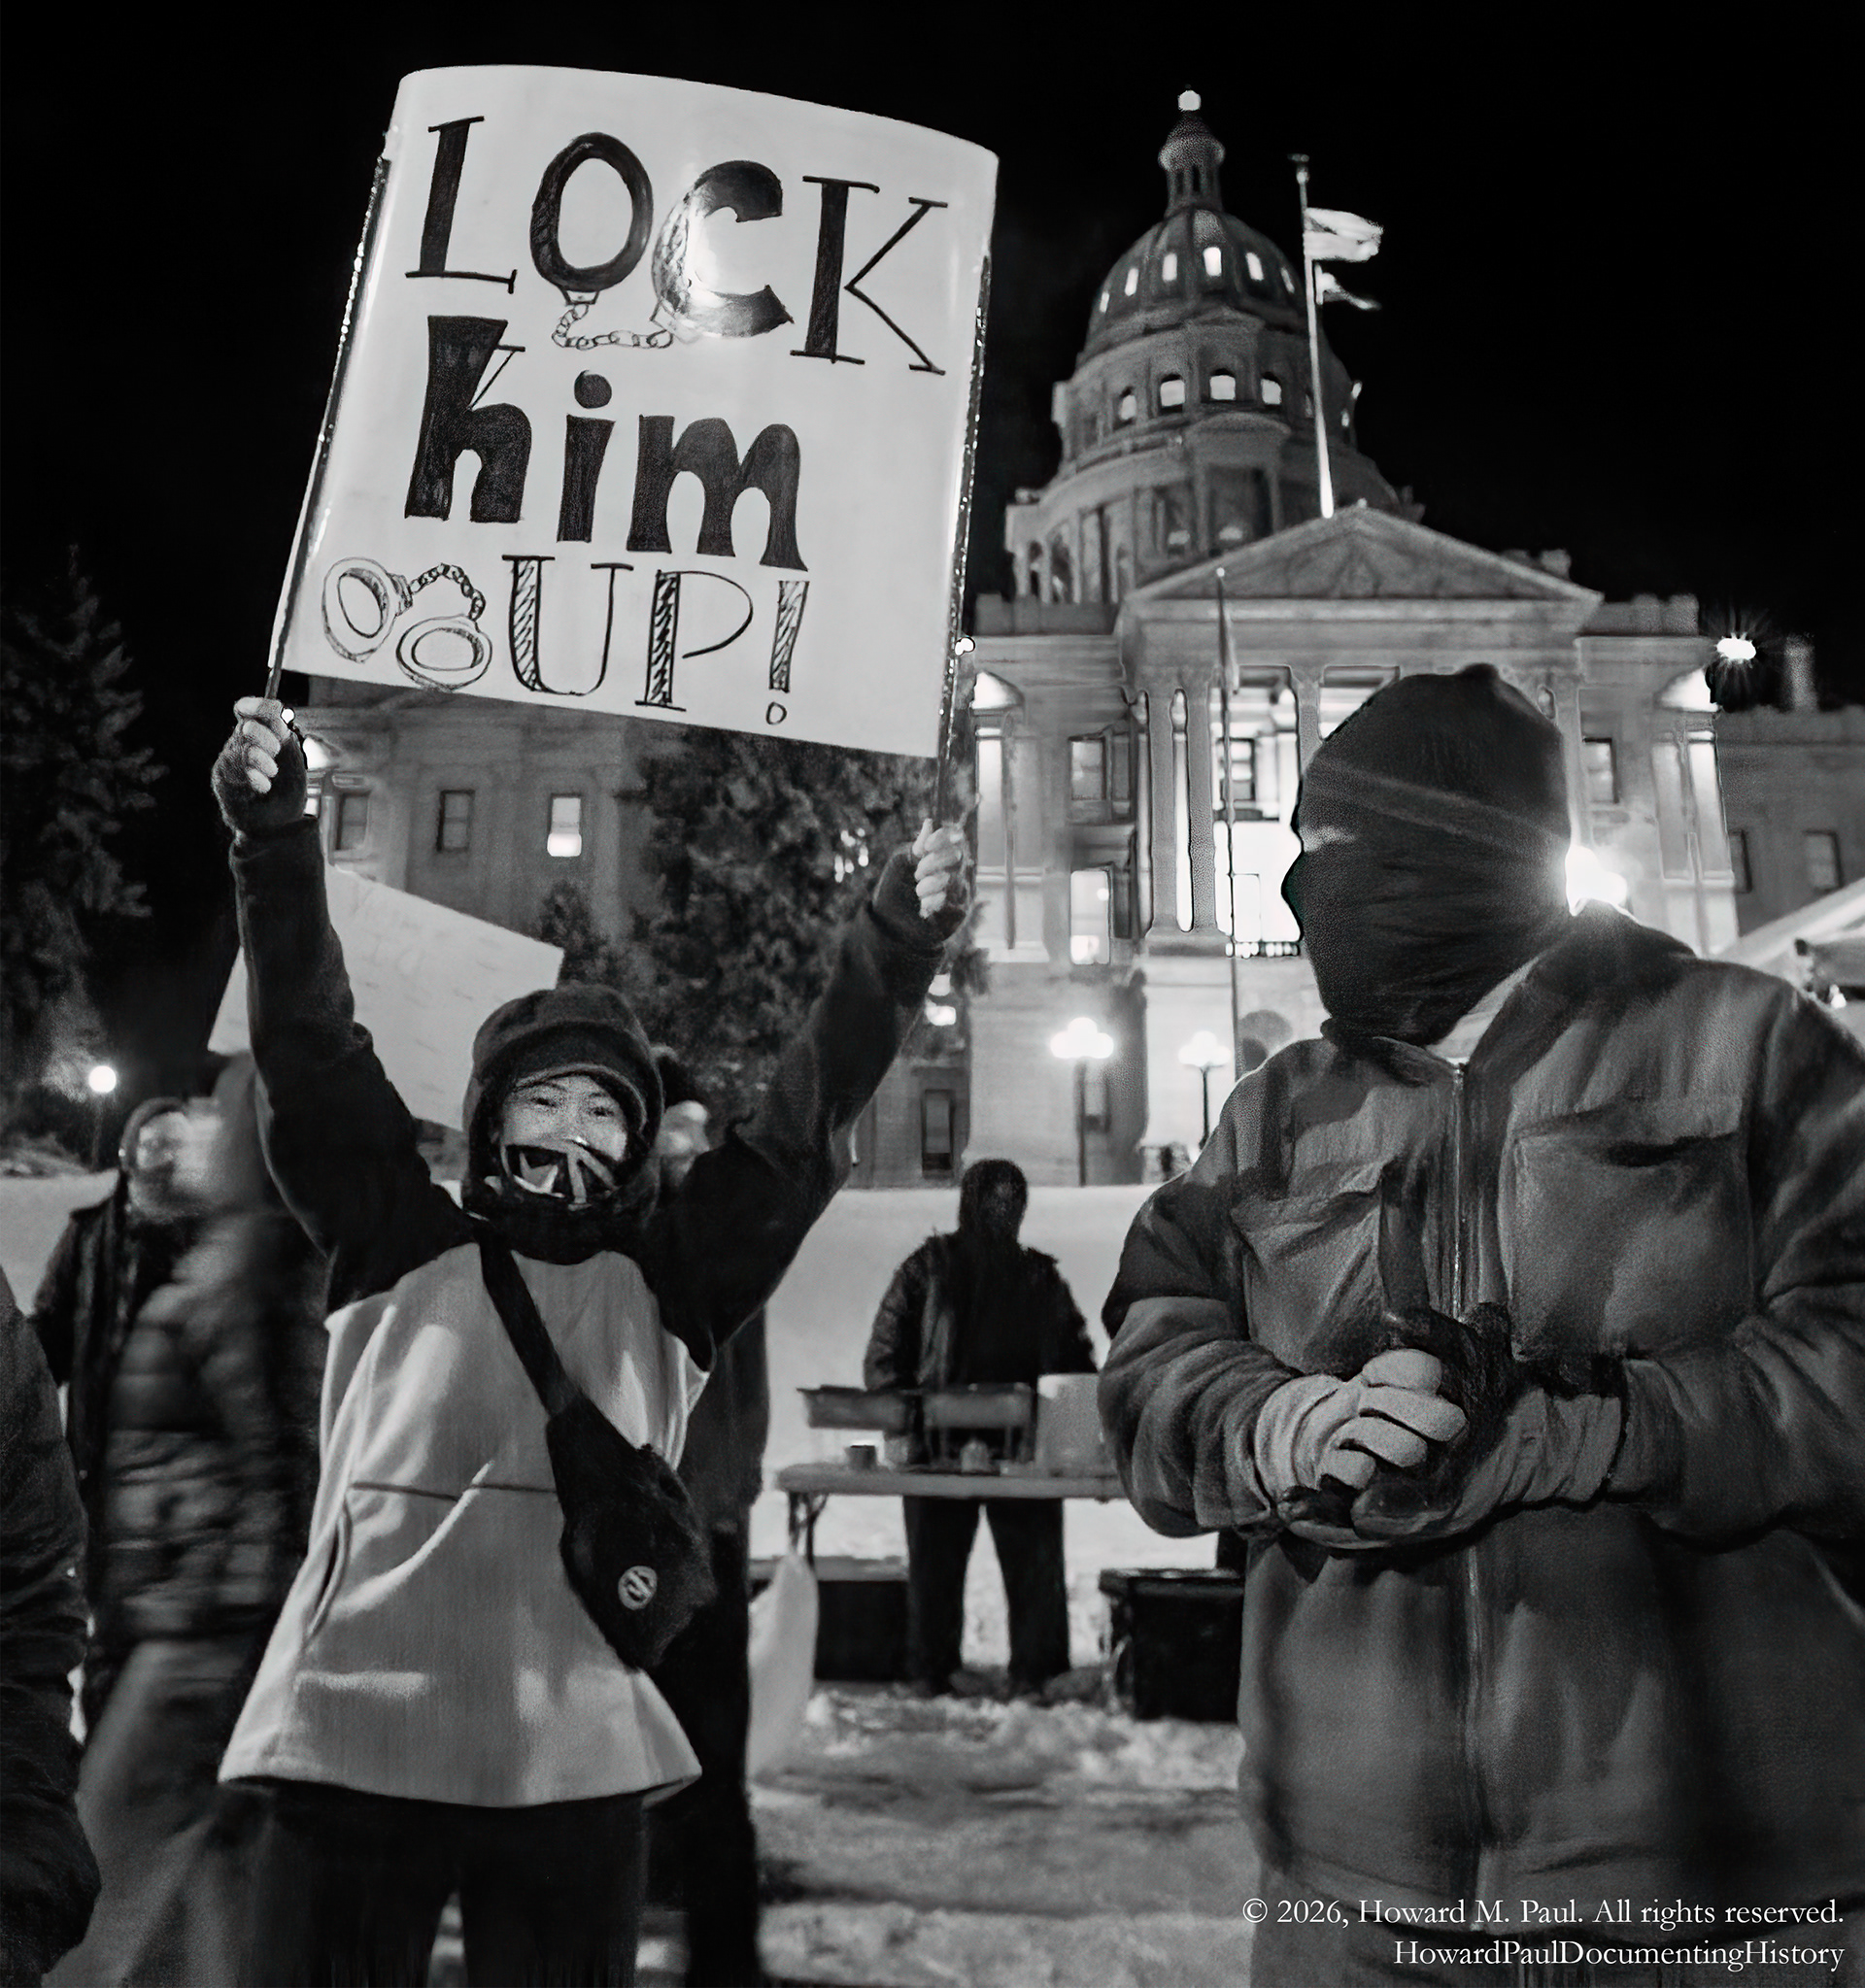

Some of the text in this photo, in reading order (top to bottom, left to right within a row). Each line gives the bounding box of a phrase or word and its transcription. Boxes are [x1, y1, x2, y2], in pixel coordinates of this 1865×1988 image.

[405, 116, 948, 376] LOCK
[403, 315, 809, 572] him
[501, 554, 810, 726] UP!
